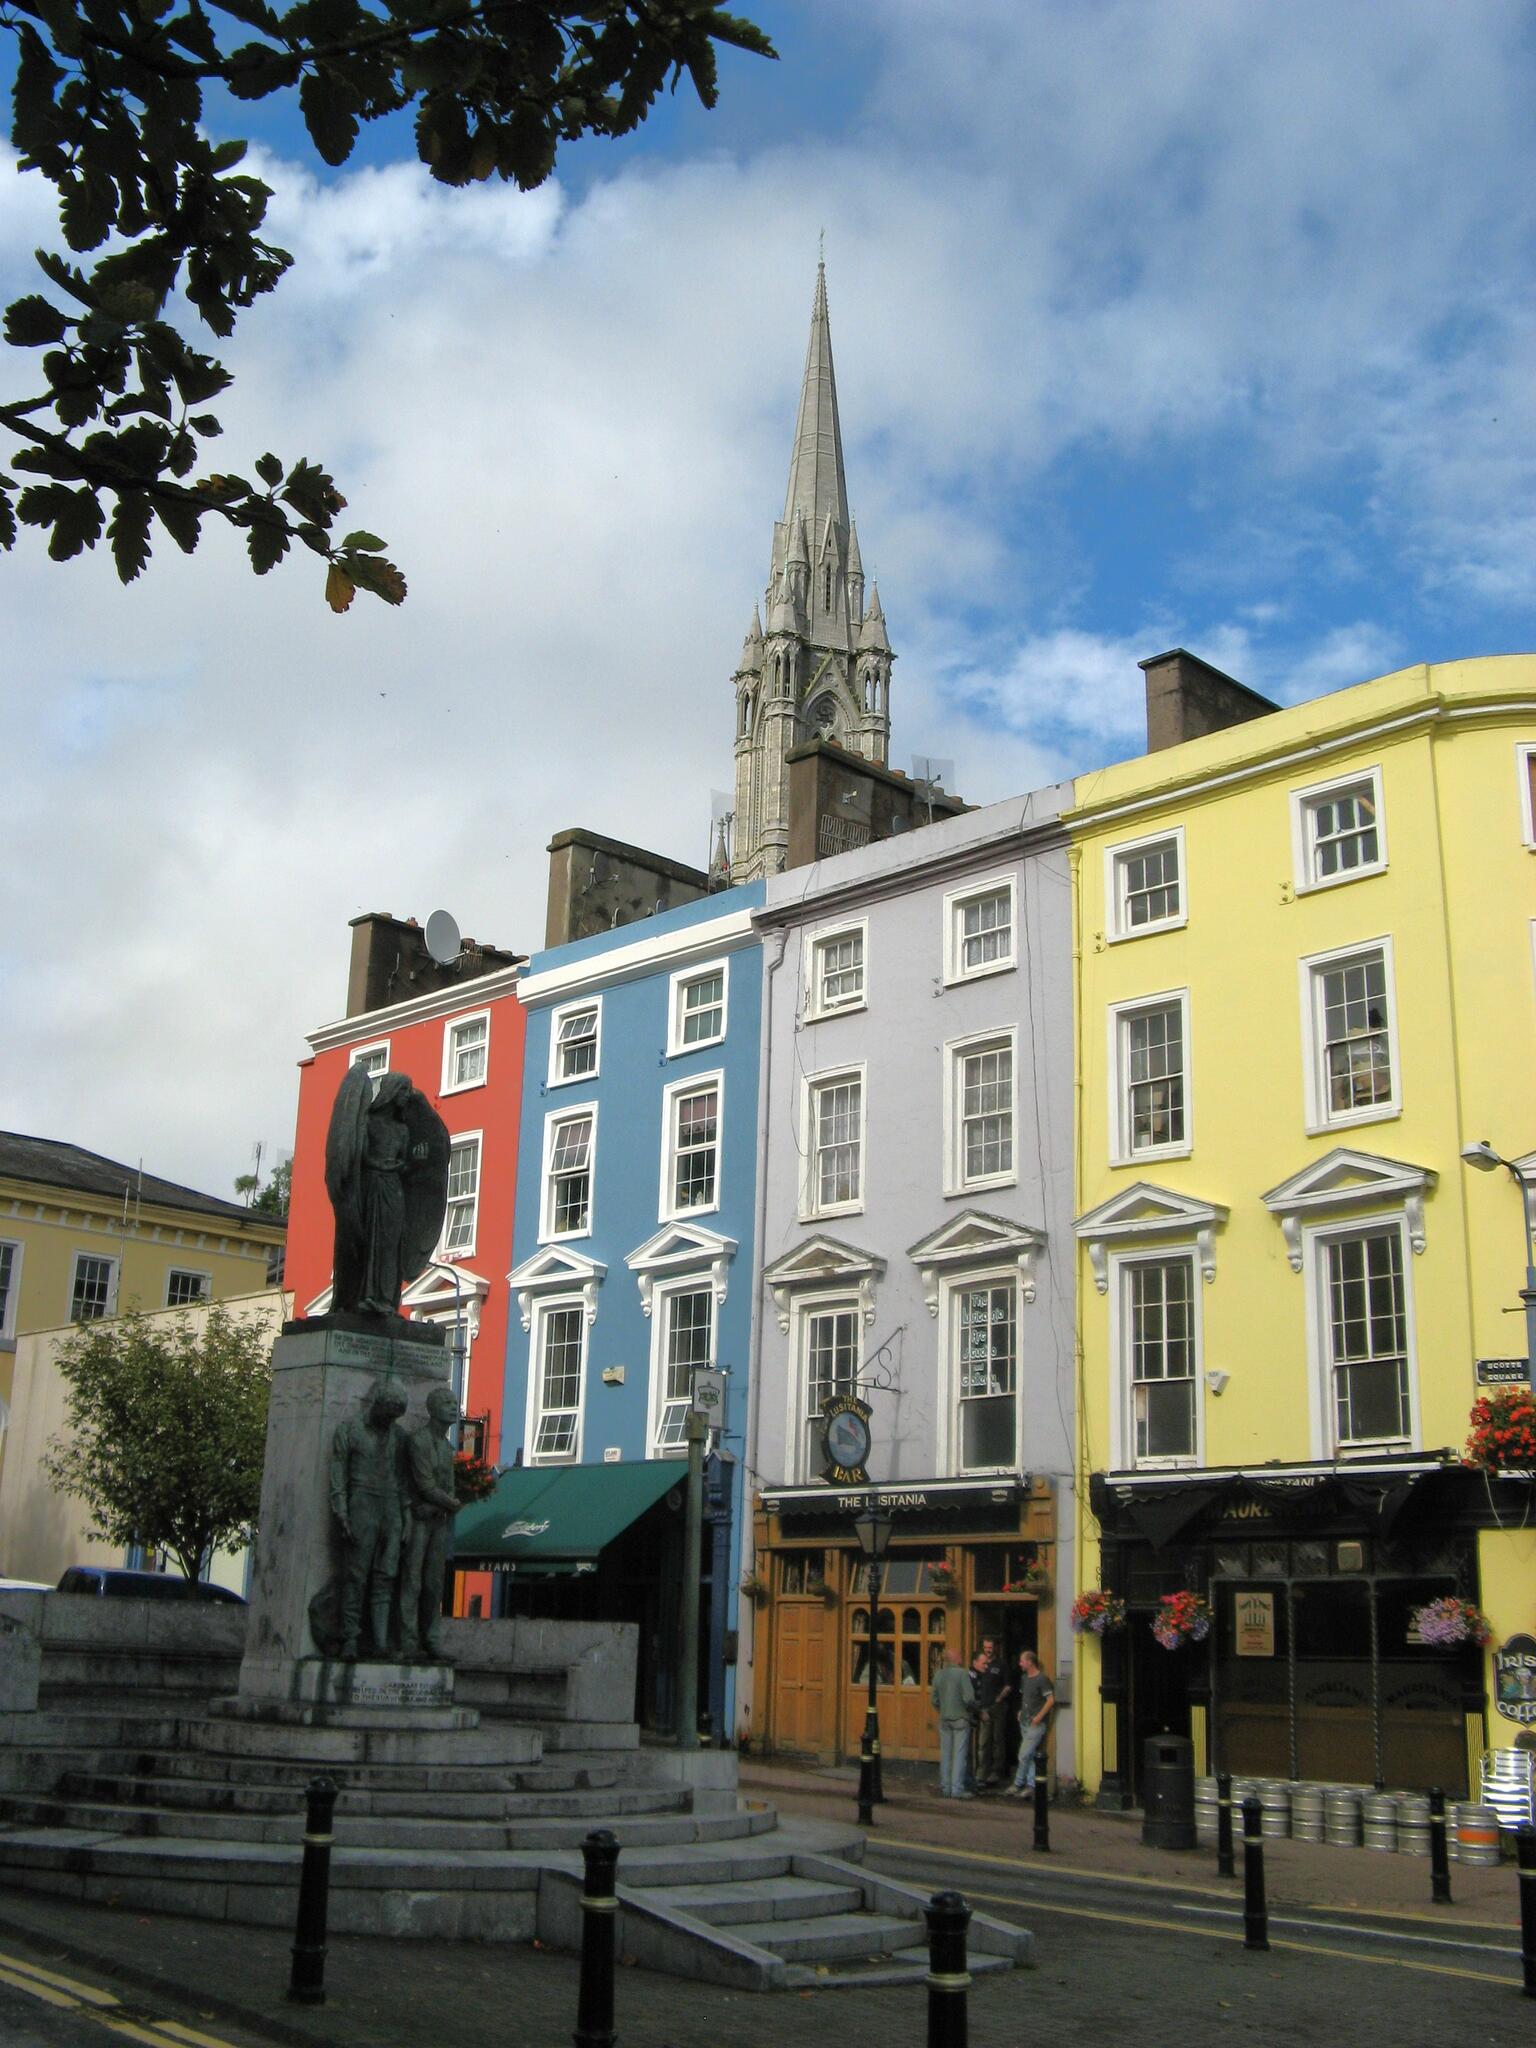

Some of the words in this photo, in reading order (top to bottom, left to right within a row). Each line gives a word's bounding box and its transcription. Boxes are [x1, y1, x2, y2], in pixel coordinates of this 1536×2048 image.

[962, 1344, 998, 1360] Studo
[961, 1372, 997, 1388] Galley
[1487, 1373, 1524, 1381] SQUARE
[842, 1394, 859, 1404] THE
[829, 1403, 868, 1424] LUSITANIA
[832, 1464, 865, 1483] BAR
[838, 1496, 861, 1508] THE
[865, 1493, 927, 1507] LSITANIA
[480, 1561, 517, 1572] RYANS
